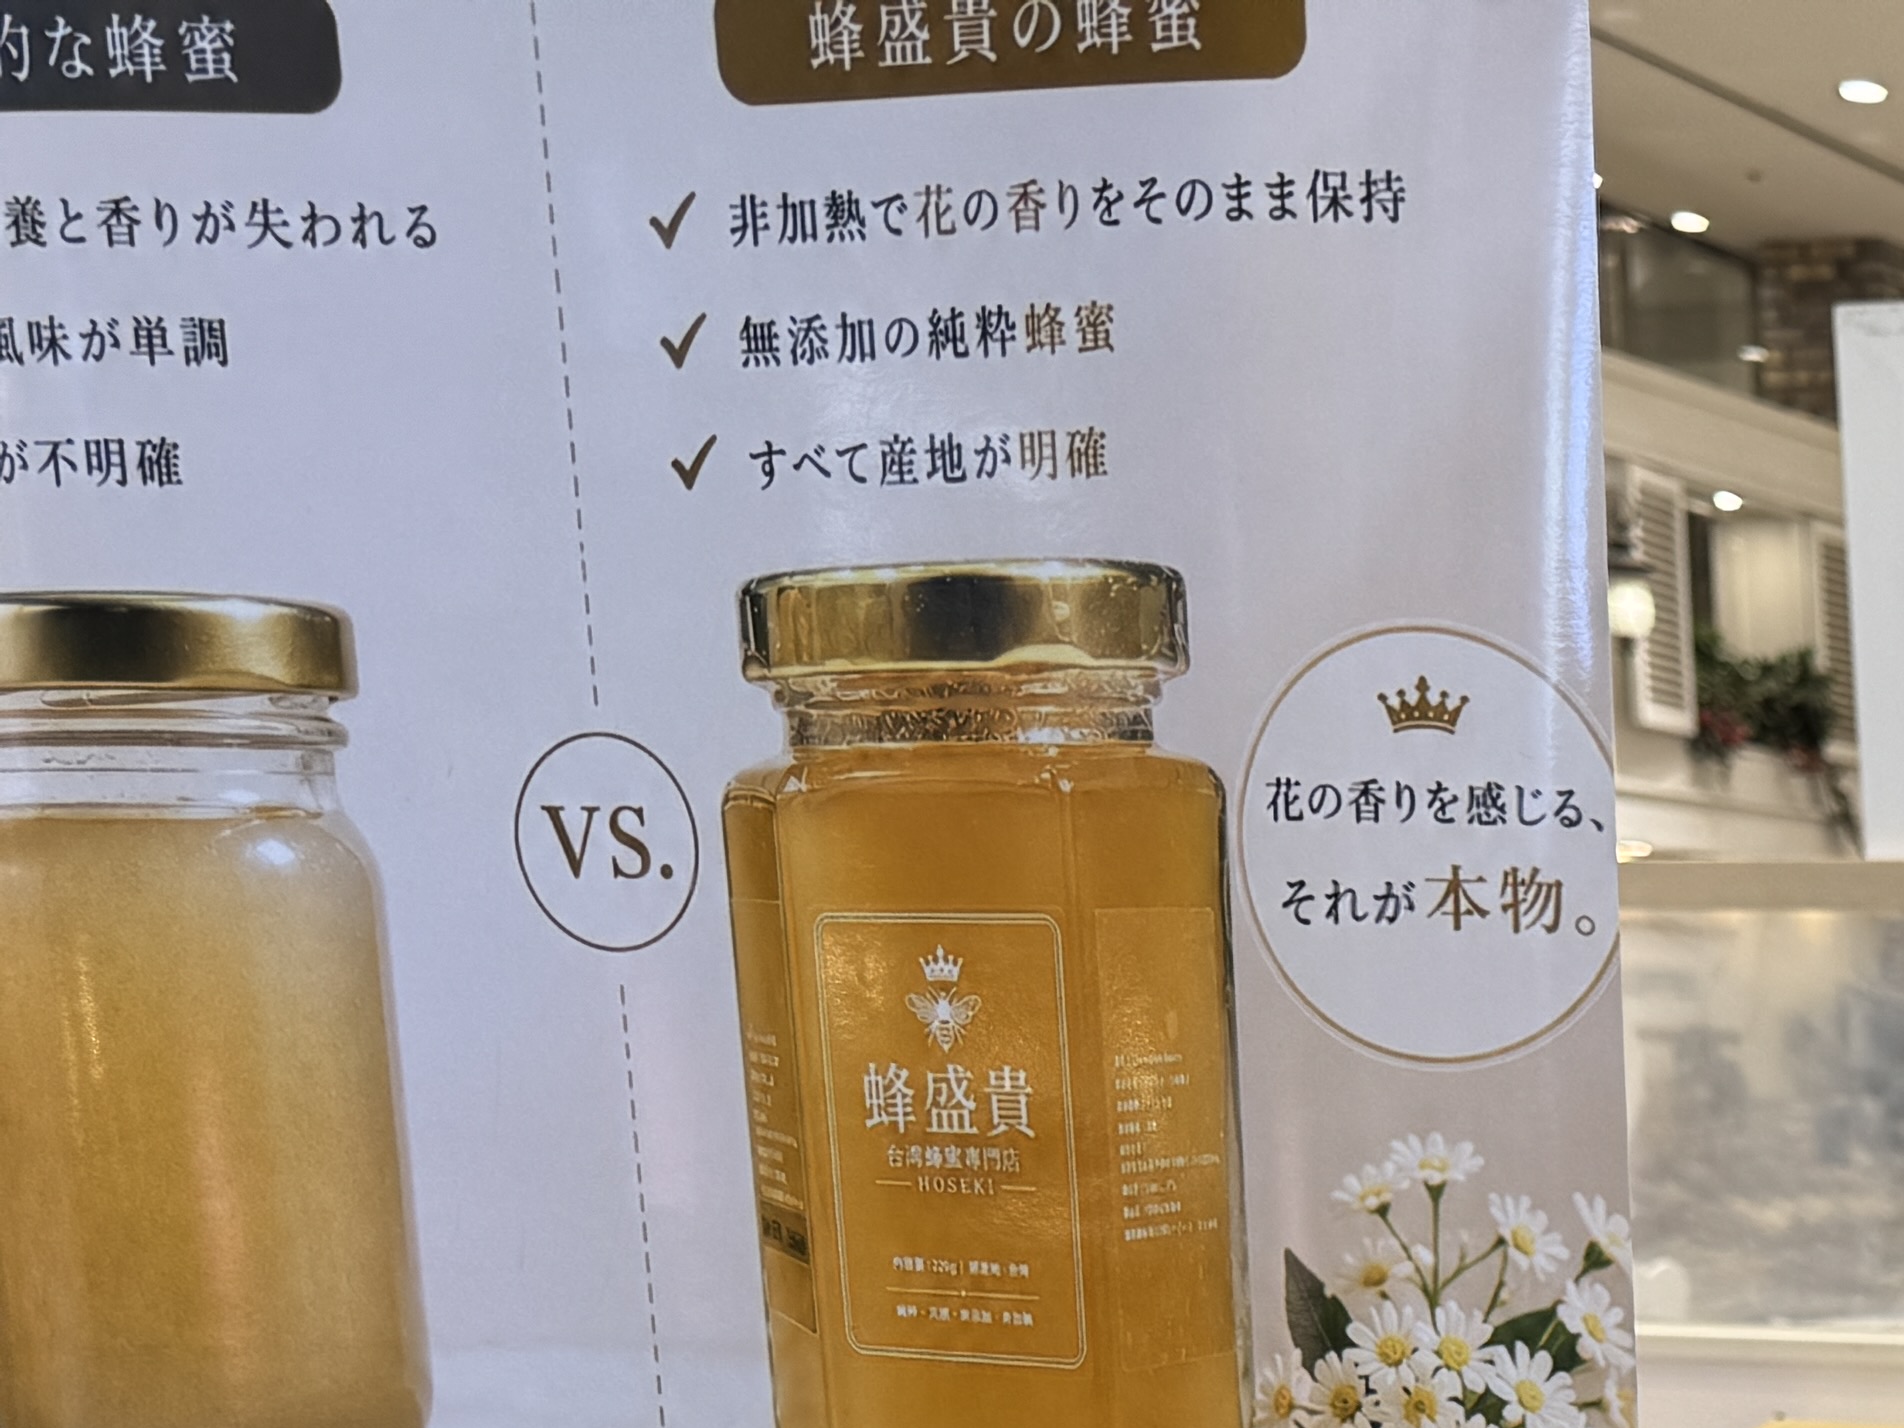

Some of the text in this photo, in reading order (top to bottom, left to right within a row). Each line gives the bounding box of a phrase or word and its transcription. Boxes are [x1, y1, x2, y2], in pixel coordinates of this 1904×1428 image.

[809, 0, 1203, 72] 蜂盛貴の蜂蜜
[5, 197, 439, 250] 養と香りが失われる
[729, 168, 1406, 249] 非加熱で花の香りをそのまま保持
[739, 299, 1117, 370] 無添加の純粋蜂蜜
[750, 427, 1110, 492] すべて産地が明確
[1264, 776, 1606, 832] 花の香りを感じる、
[542, 803, 677, 881] VS.
[1280, 864, 1597, 937] それが本物。
[863, 1062, 1036, 1139] 蜂盛貴
[918, 1176, 995, 1195] HOSEKI
